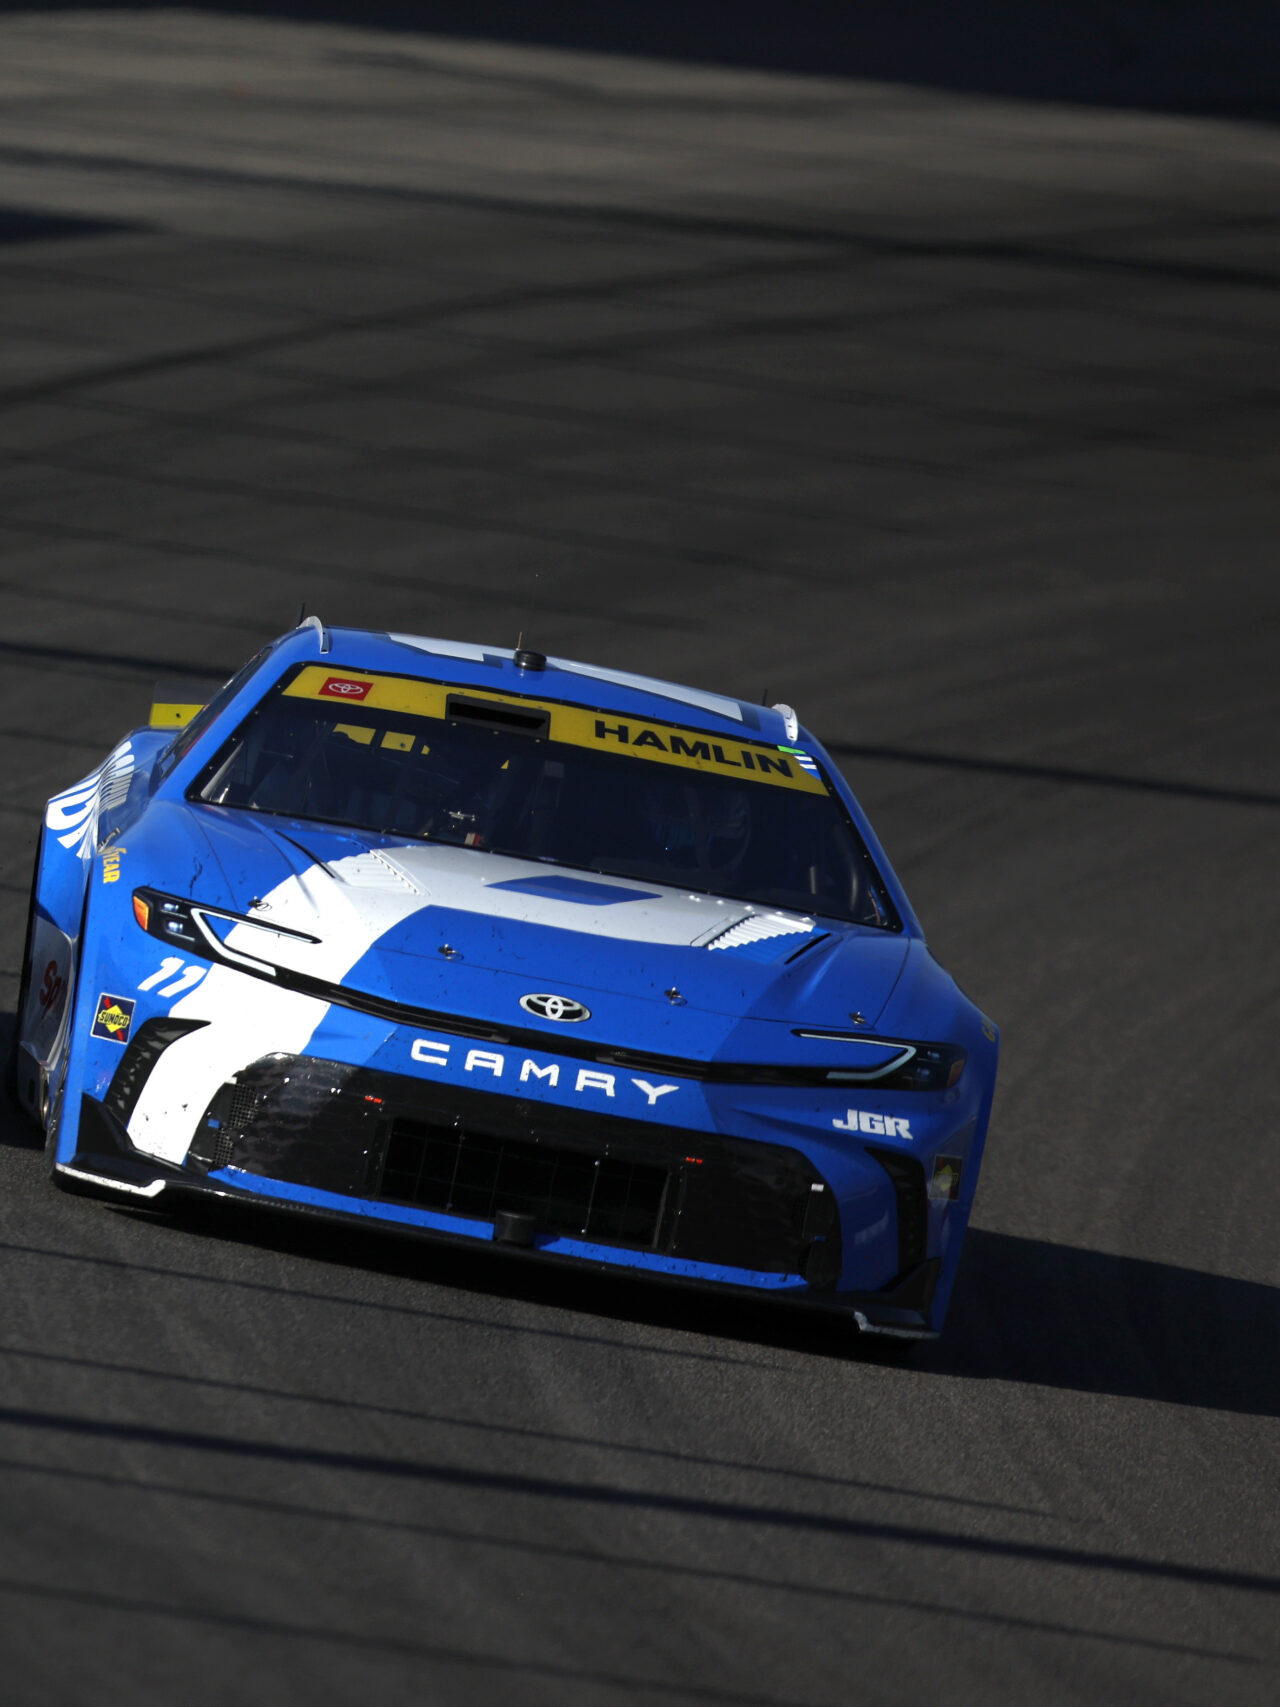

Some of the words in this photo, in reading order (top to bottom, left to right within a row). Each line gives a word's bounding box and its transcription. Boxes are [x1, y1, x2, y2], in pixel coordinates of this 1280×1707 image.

[594, 719, 794, 778] HAMLIN
[136, 956, 208, 999] 11
[99, 1010, 130, 1028] SUNOCO
[410, 1037, 680, 1106] CAMRY
[831, 1108, 914, 1140] JGR
